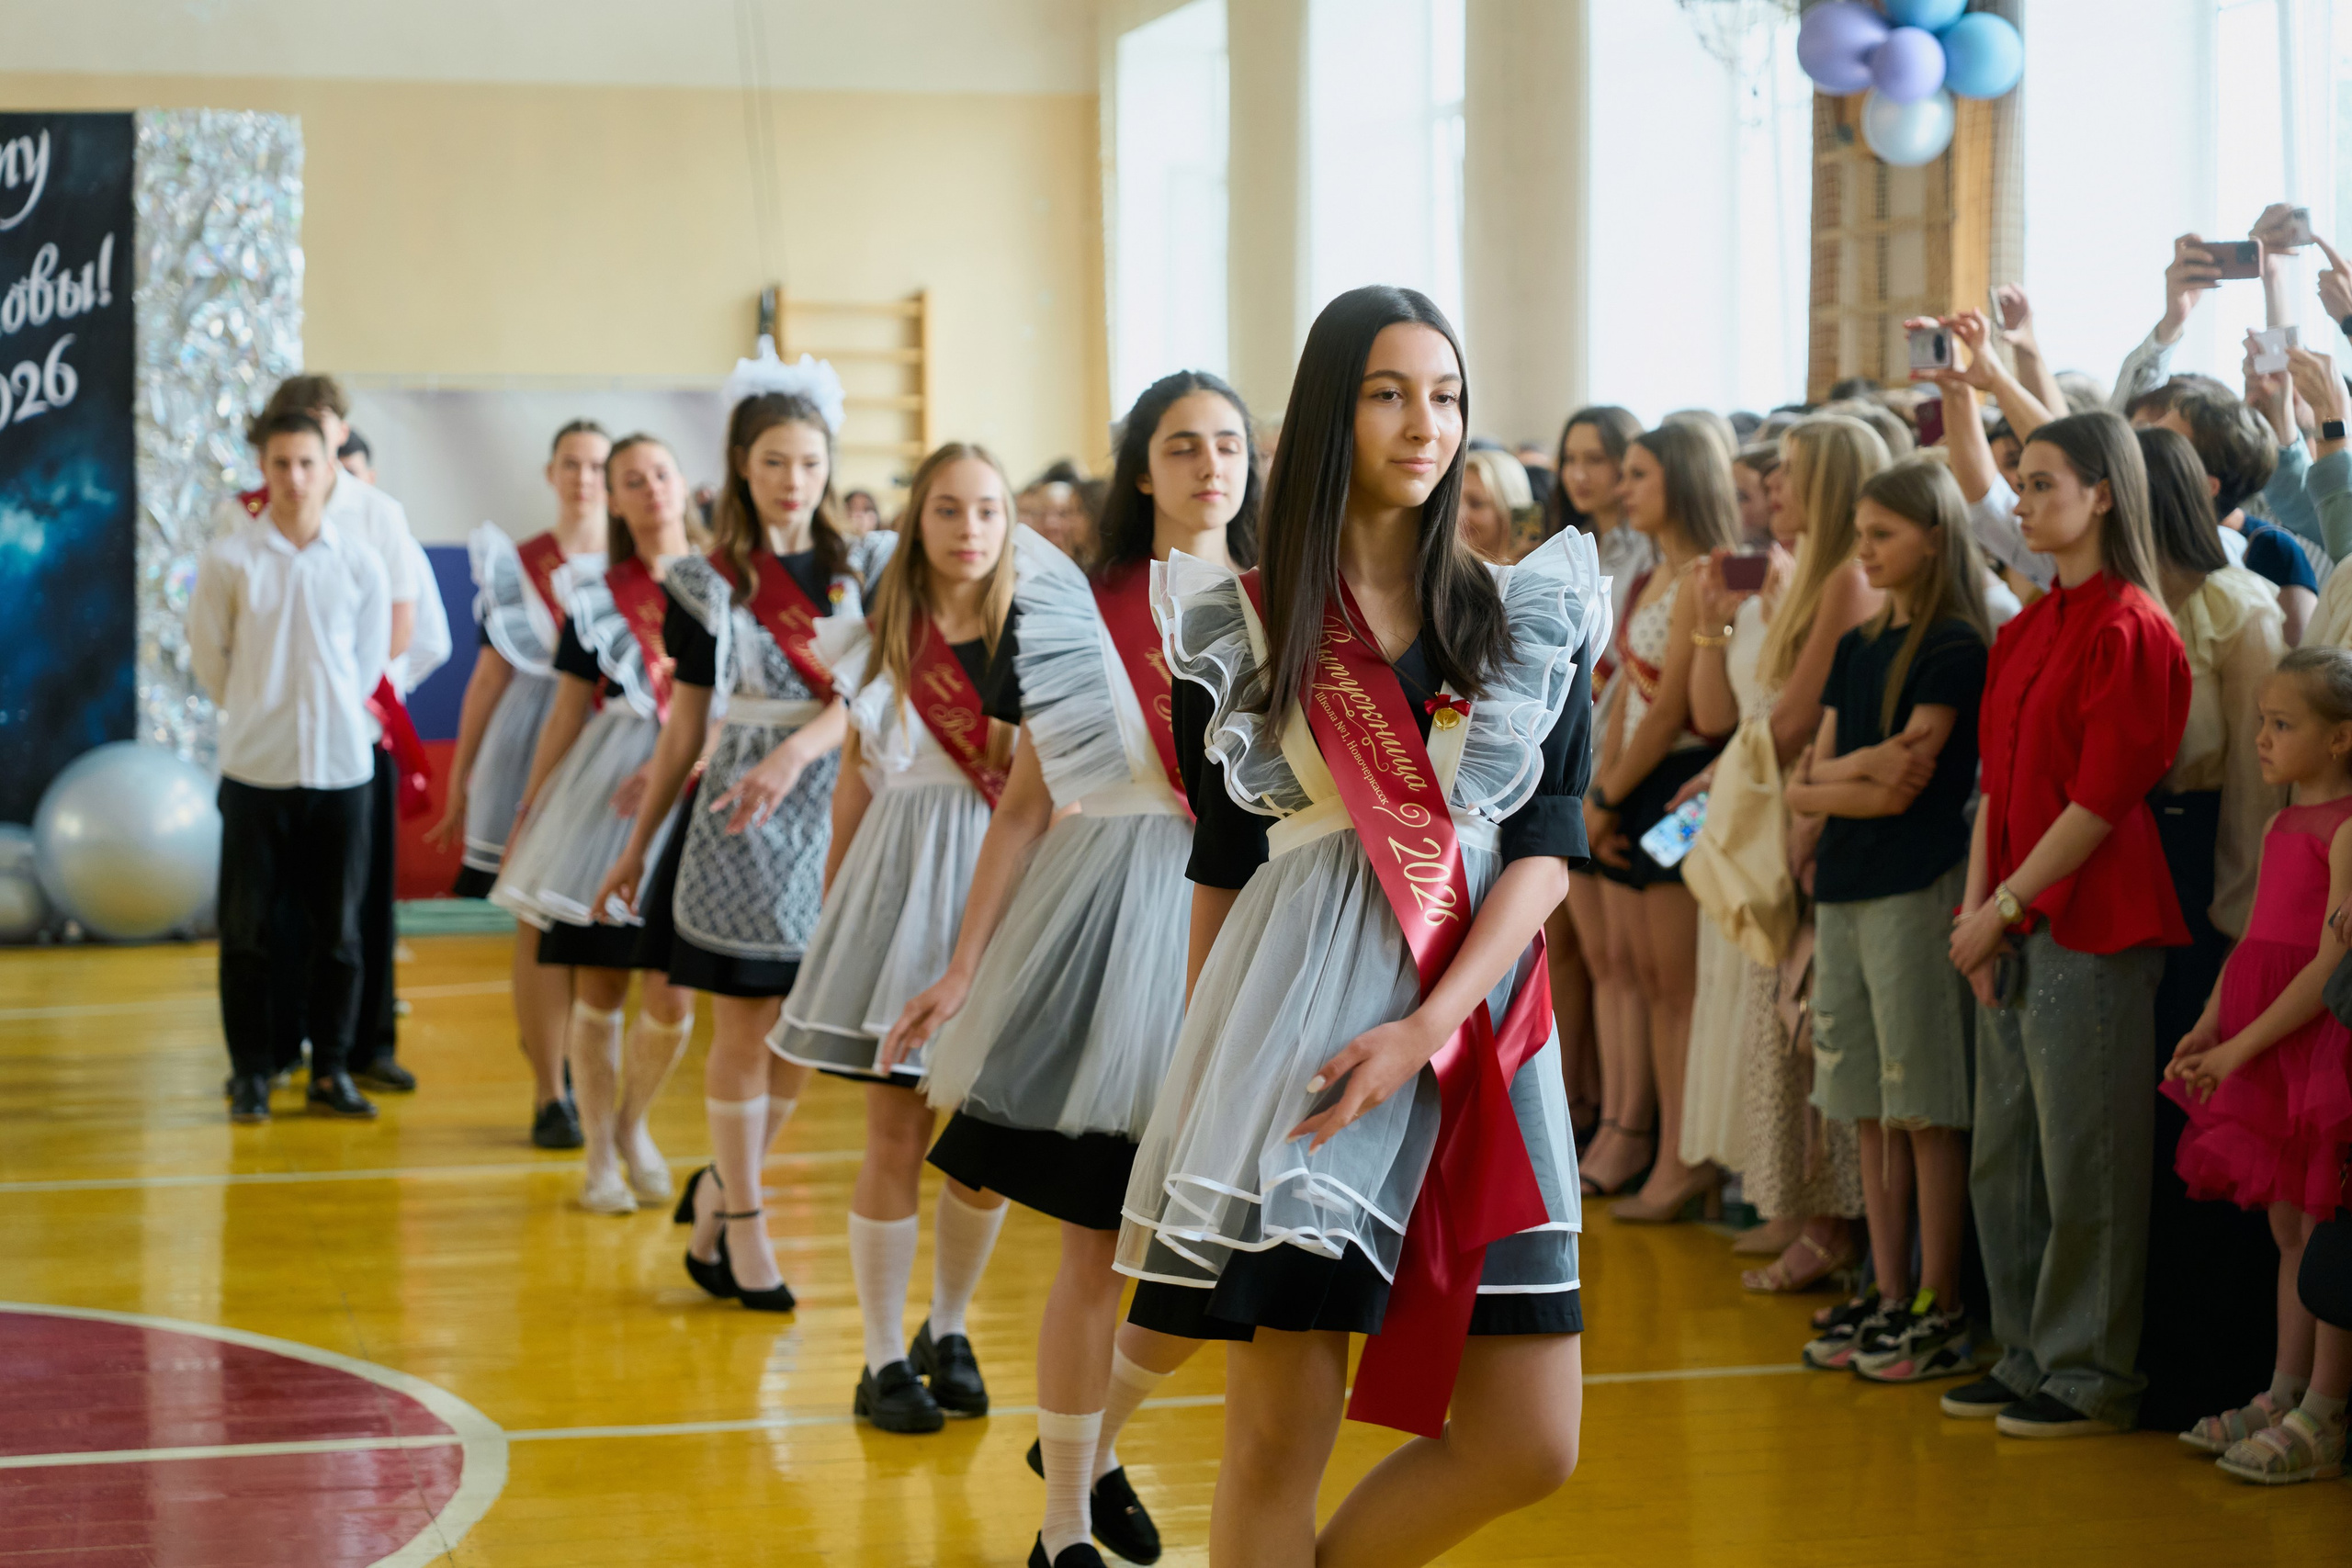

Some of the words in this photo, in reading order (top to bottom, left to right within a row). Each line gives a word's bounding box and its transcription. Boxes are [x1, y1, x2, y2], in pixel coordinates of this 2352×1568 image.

[1311, 615, 1428, 792] Выпускница
[1388, 836, 1459, 927] 2026
[1315, 692, 1338, 722] Школа
[1347, 740, 1389, 806] Новочеркасск
